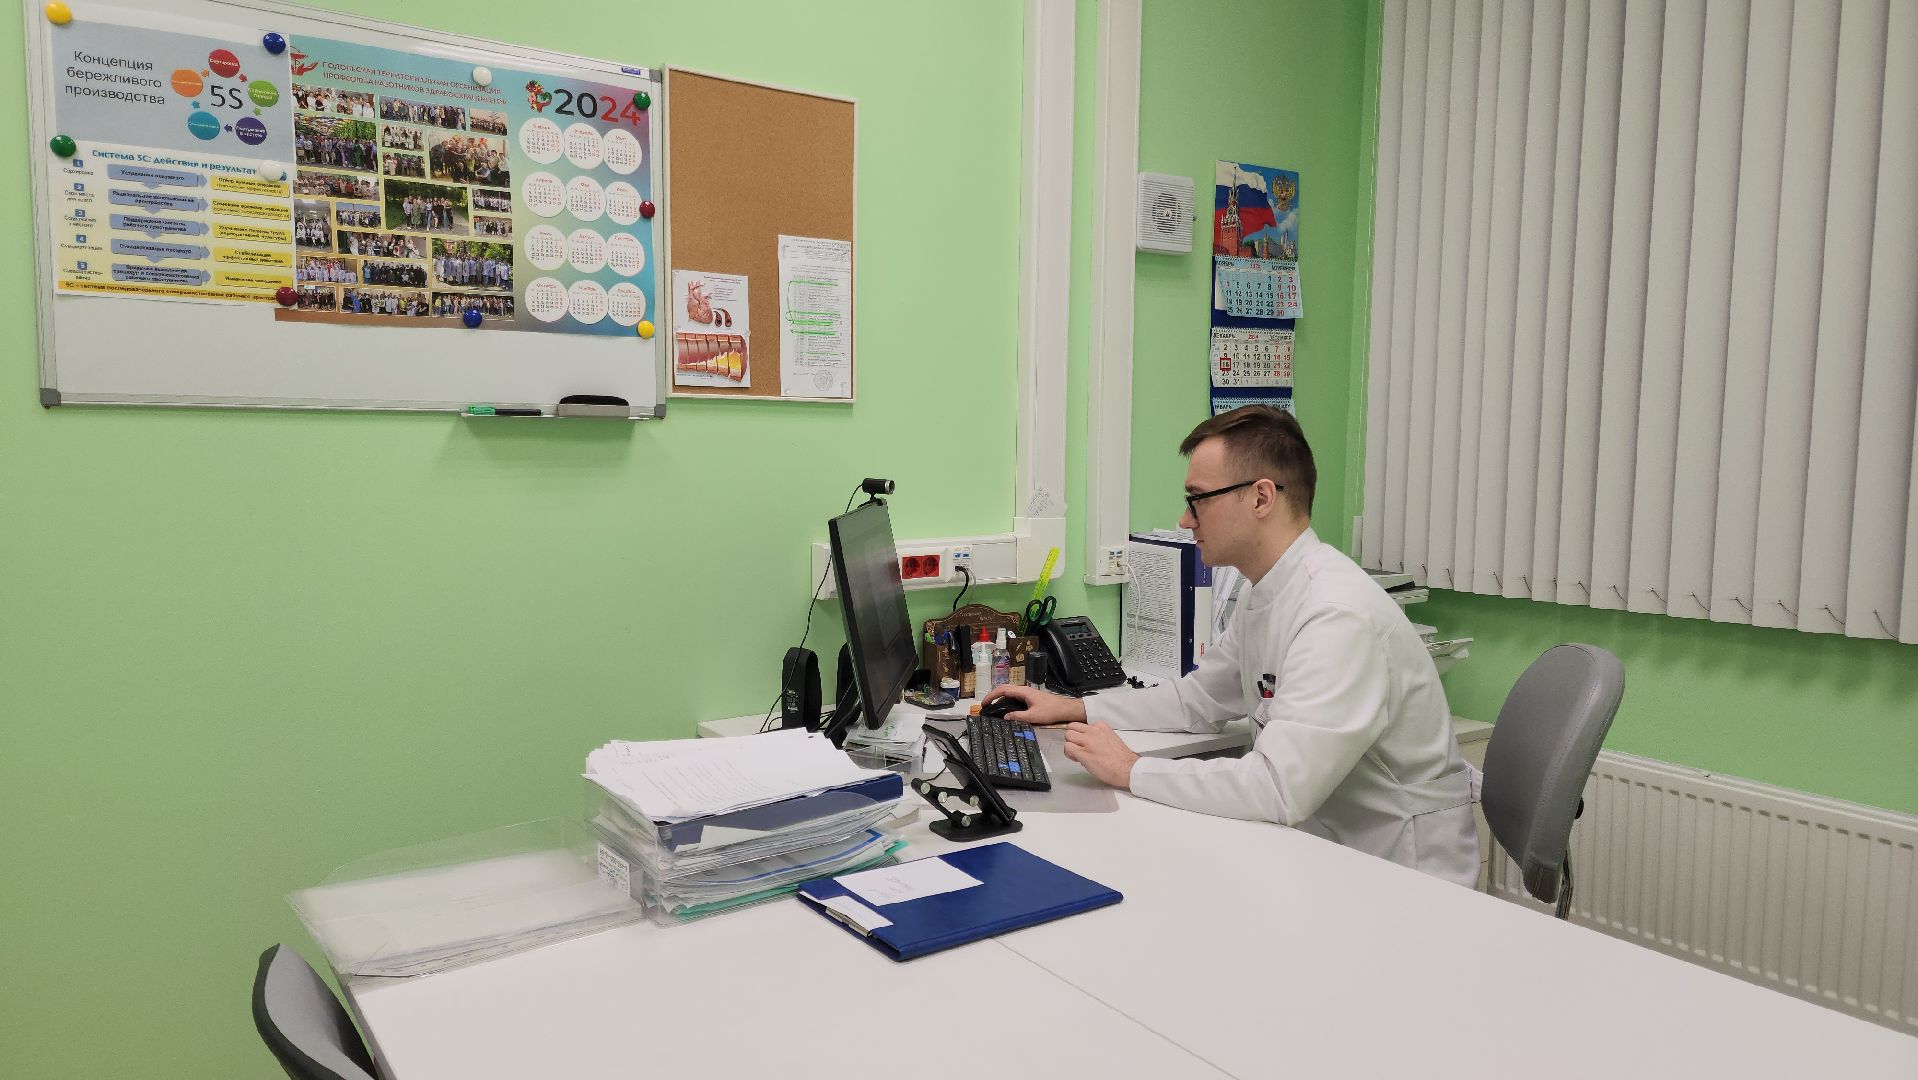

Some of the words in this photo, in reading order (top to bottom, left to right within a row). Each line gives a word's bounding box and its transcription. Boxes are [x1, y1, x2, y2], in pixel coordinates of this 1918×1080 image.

[74, 50, 153, 71] Концепция
[66, 66, 162, 88] бережливого
[65, 85, 165, 105] производства
[210, 85, 244, 109] 5S
[553, 88, 641, 126] 2024
[92, 149, 135, 161] Система
[153, 156, 199, 168] действия
[1287, 292, 1297, 300] 17
[1256, 308, 1263, 316] 28
[1266, 308, 1274, 316] 29
